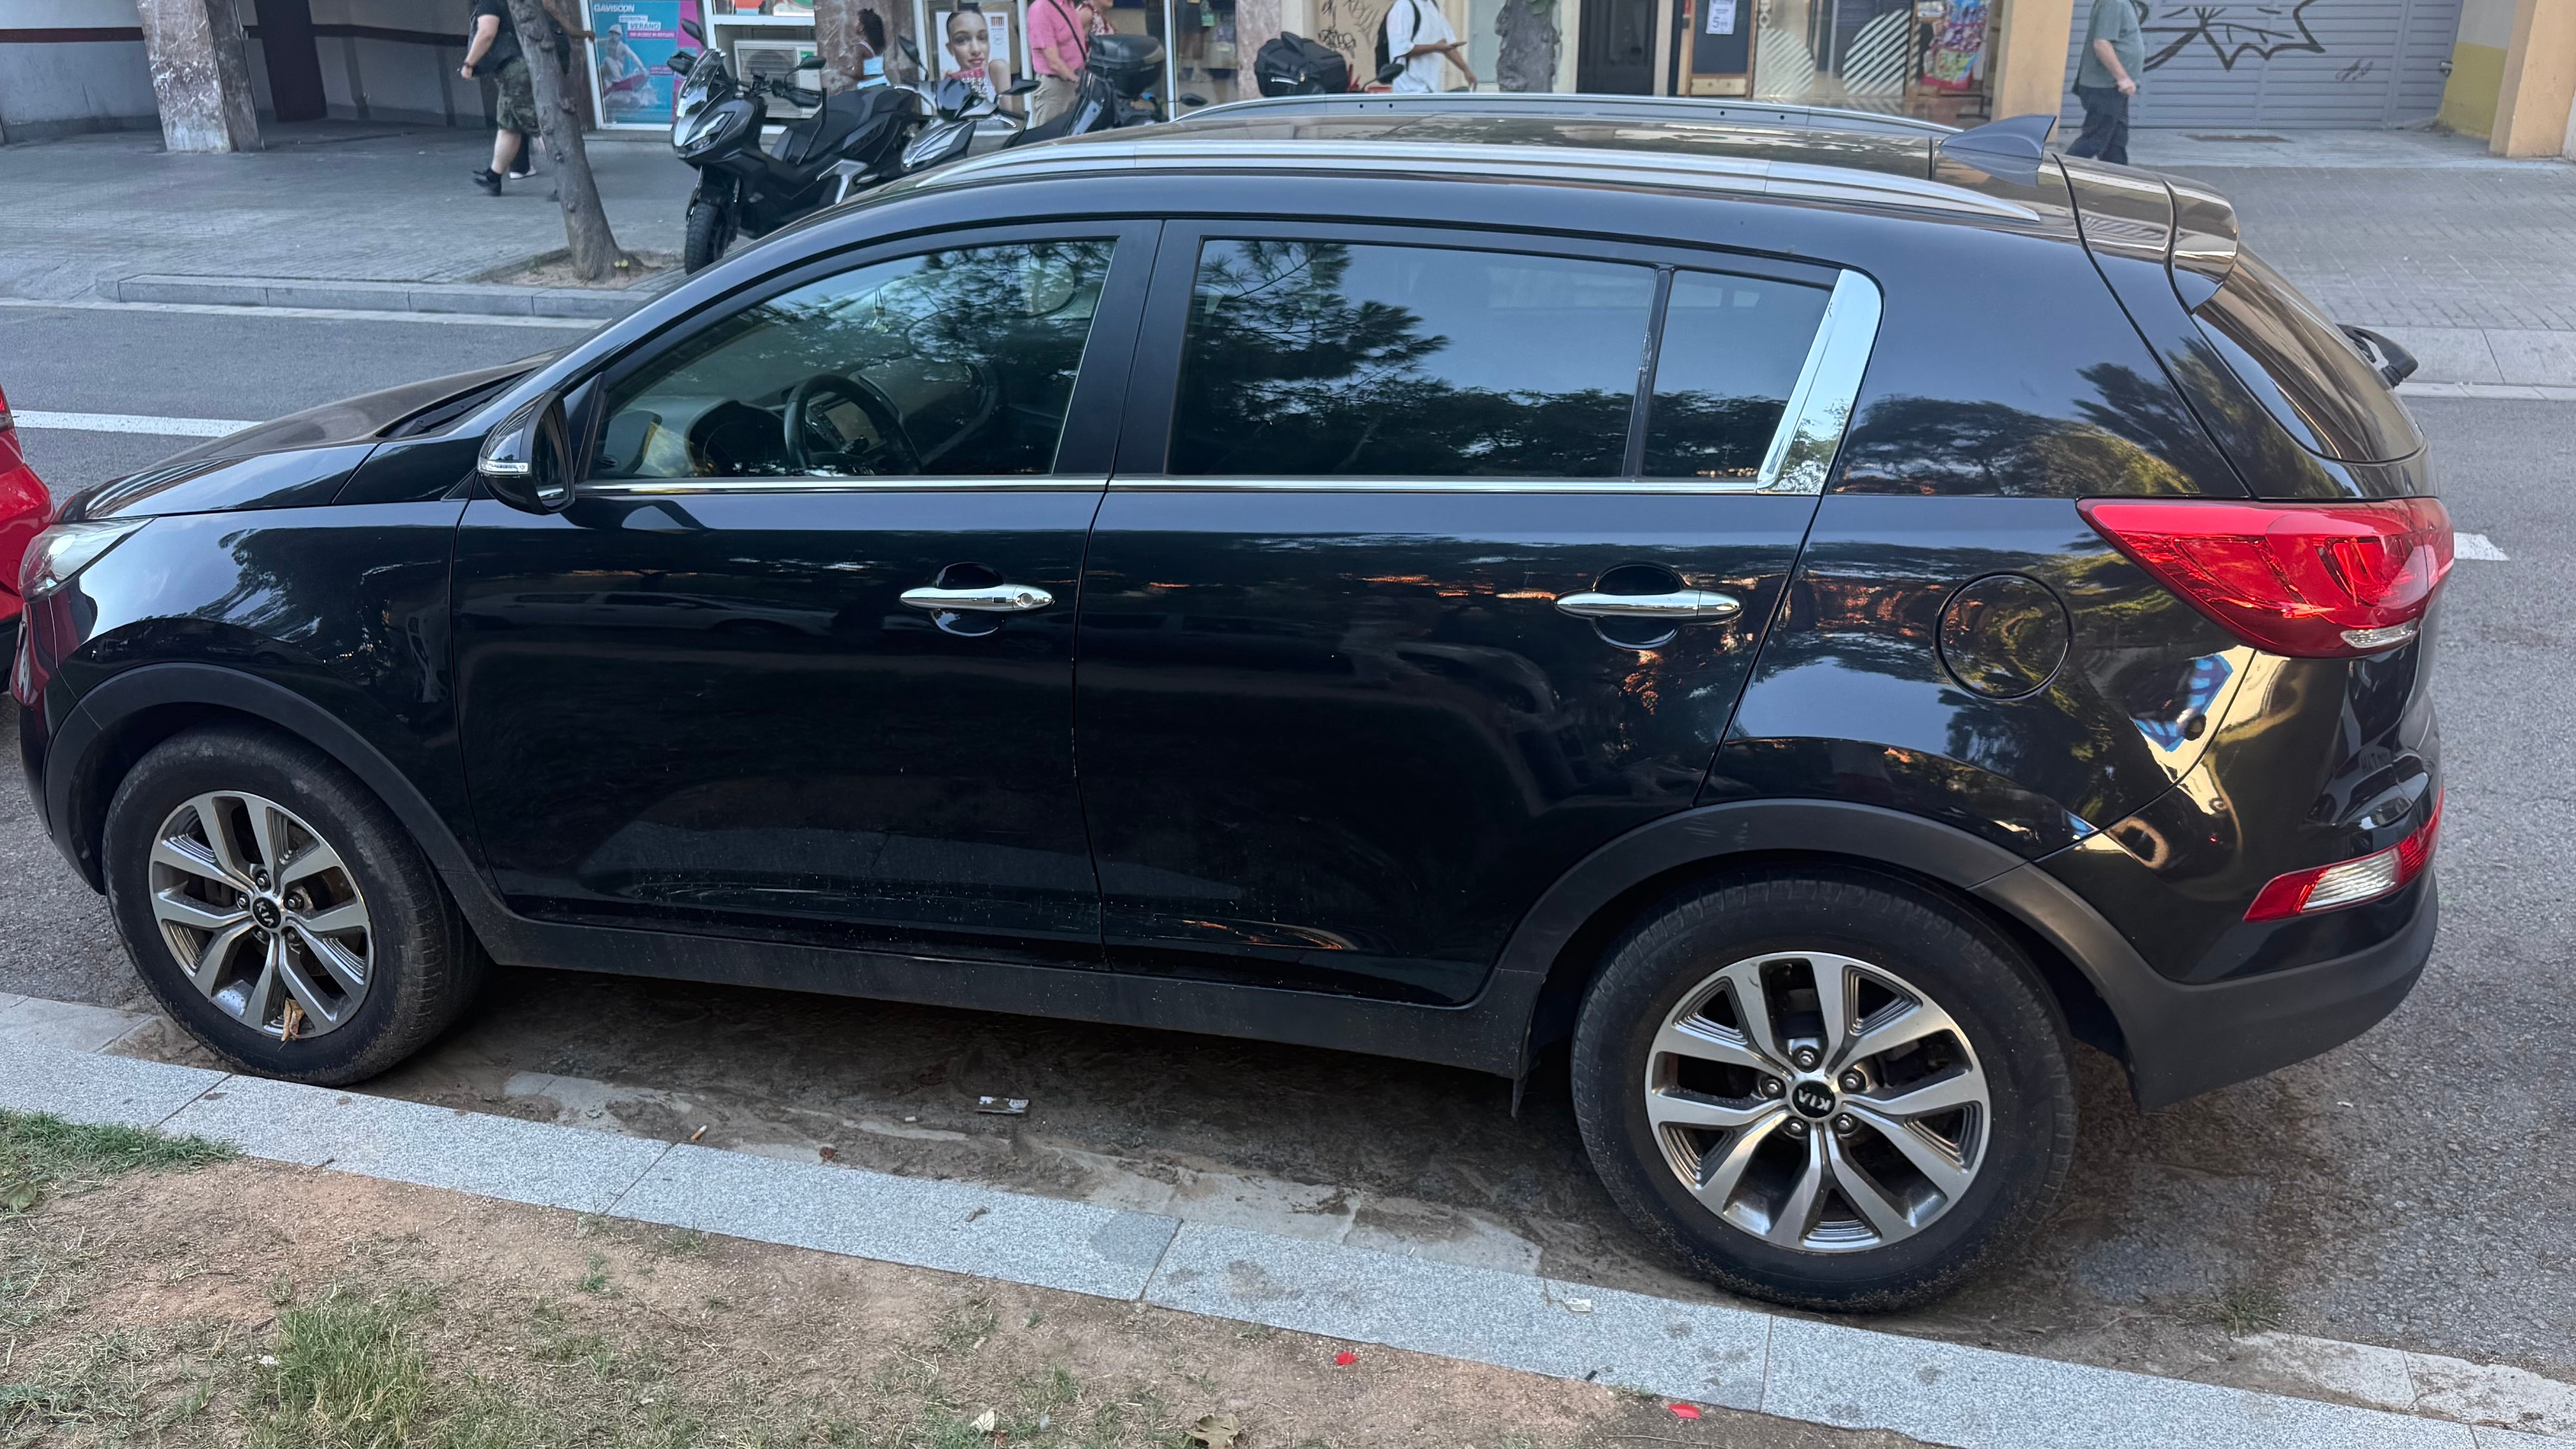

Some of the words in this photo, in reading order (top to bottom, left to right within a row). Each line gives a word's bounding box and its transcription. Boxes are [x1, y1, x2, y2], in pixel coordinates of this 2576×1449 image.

[594, 4, 634, 12] GAVISCON
[257, 901, 274, 927] KIA
[1798, 1089, 1831, 1112] KIA
